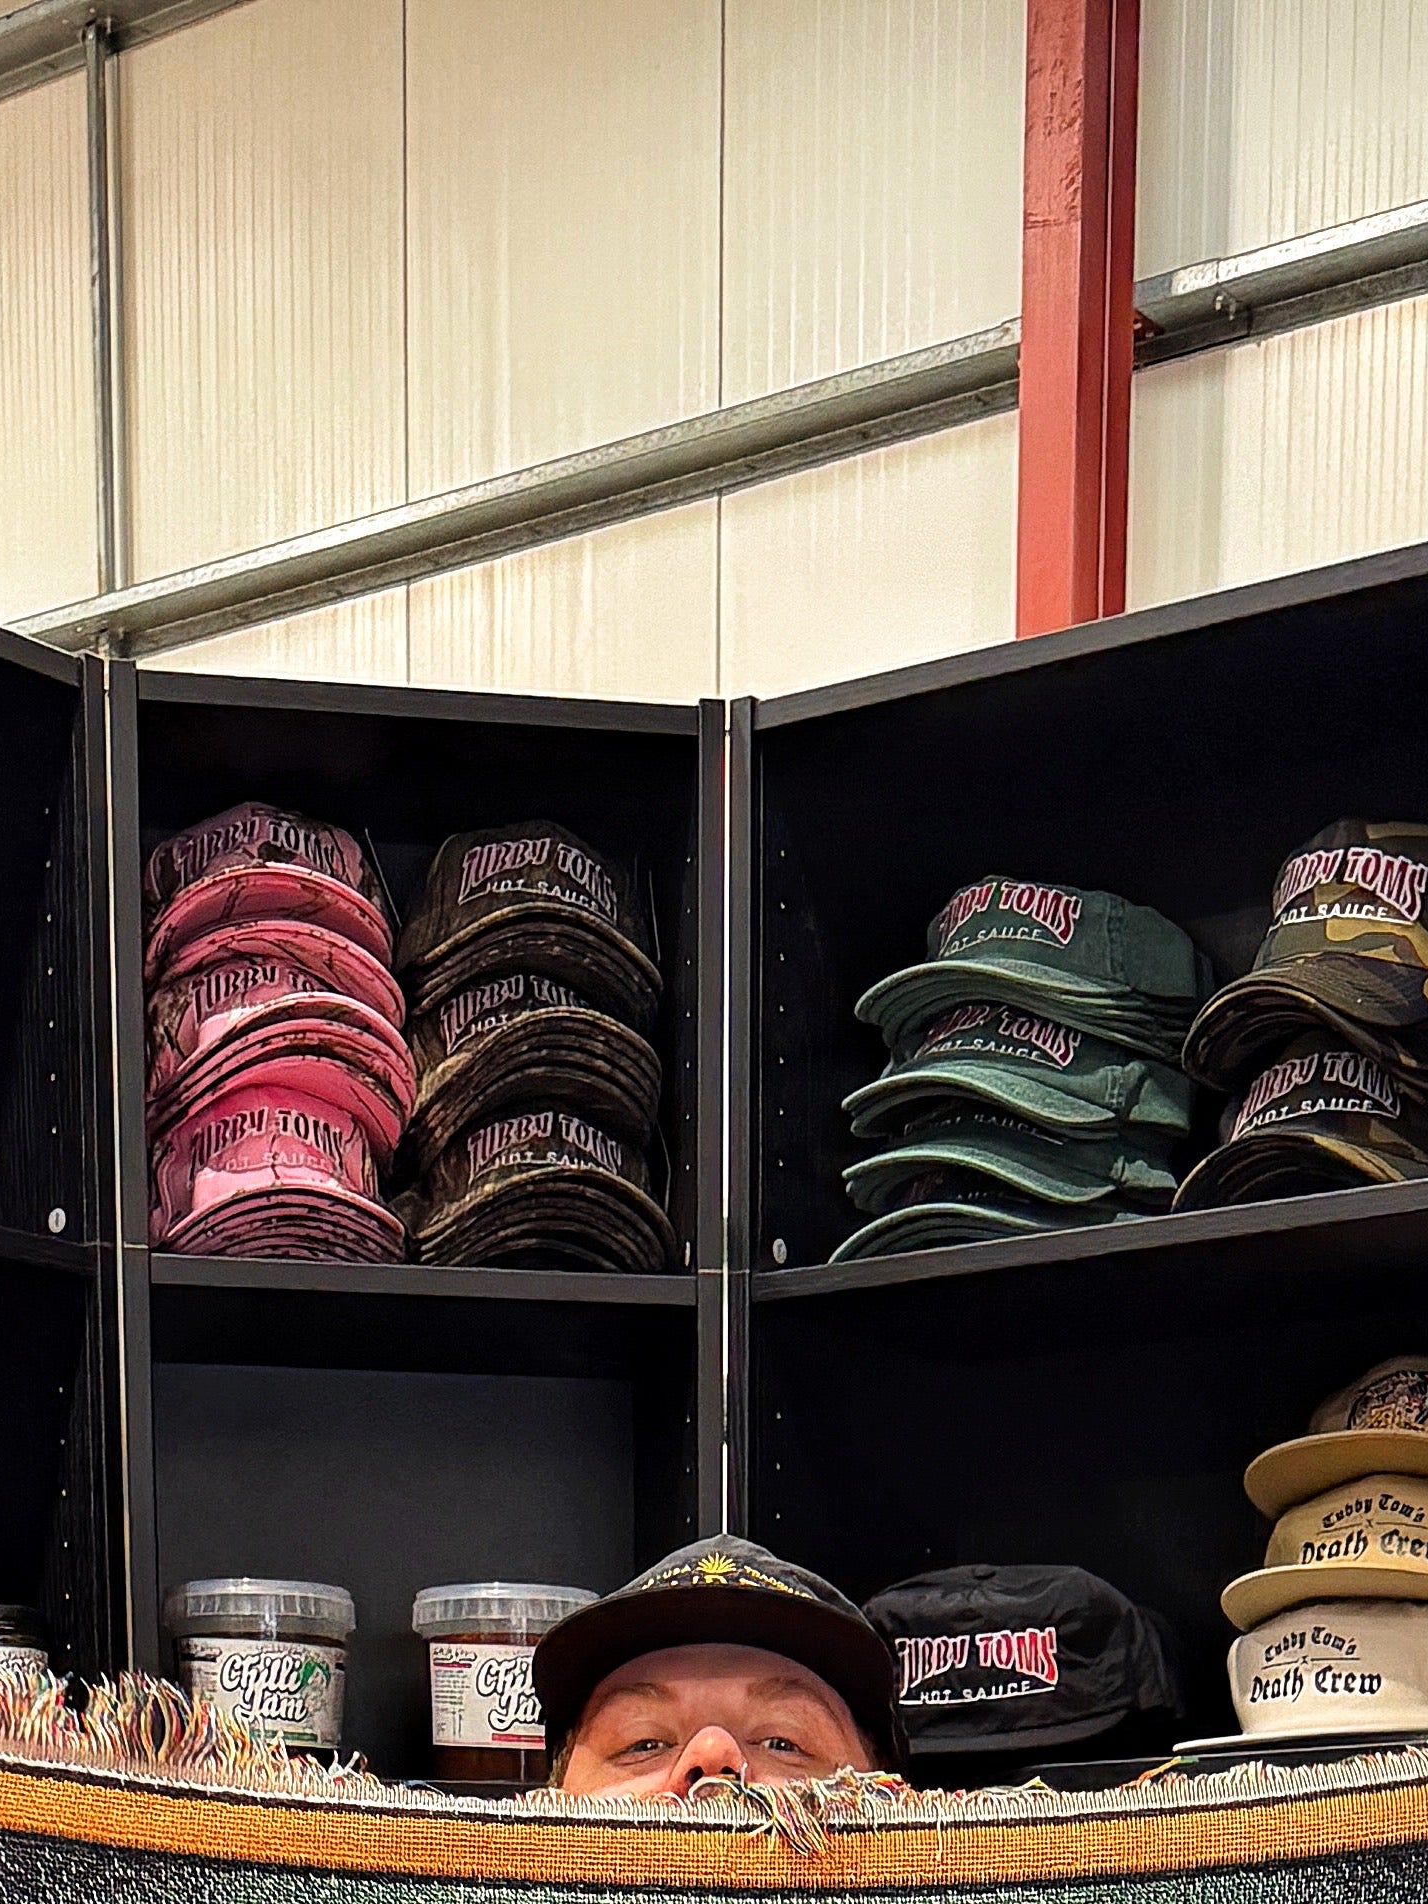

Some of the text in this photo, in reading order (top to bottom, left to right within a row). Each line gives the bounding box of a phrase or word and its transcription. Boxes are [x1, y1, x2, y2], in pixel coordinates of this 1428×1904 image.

[458, 838, 617, 925] TUBBY TOMS
[486, 879, 599, 912] HOT SAUCE
[999, 881, 1082, 945] TOMS
[1318, 903, 1388, 918] SAUCE
[977, 927, 1042, 941] SAUCE
[190, 965, 279, 1030] TUBBY
[440, 975, 524, 1056] TUBBY
[974, 1039, 1042, 1060] SAUCE
[998, 1011, 1082, 1066] TOMS
[1301, 1098, 1374, 1112] SAUCE
[189, 1107, 269, 1192] TUBBY
[468, 1112, 622, 1186] TUBBY TOMS
[1322, 1491, 1426, 1530] Tubby Tom's
[1301, 1529, 1369, 1567] Death
[896, 1626, 1059, 1698] TUBBY TOMS
[1263, 1625, 1359, 1664] Tubby Tom's
[220, 1651, 303, 1692] Chilli
[1249, 1665, 1382, 1704] Death Crew
[234, 1690, 308, 1722] Jam
[919, 1679, 1032, 1704] HOT SAUCE
